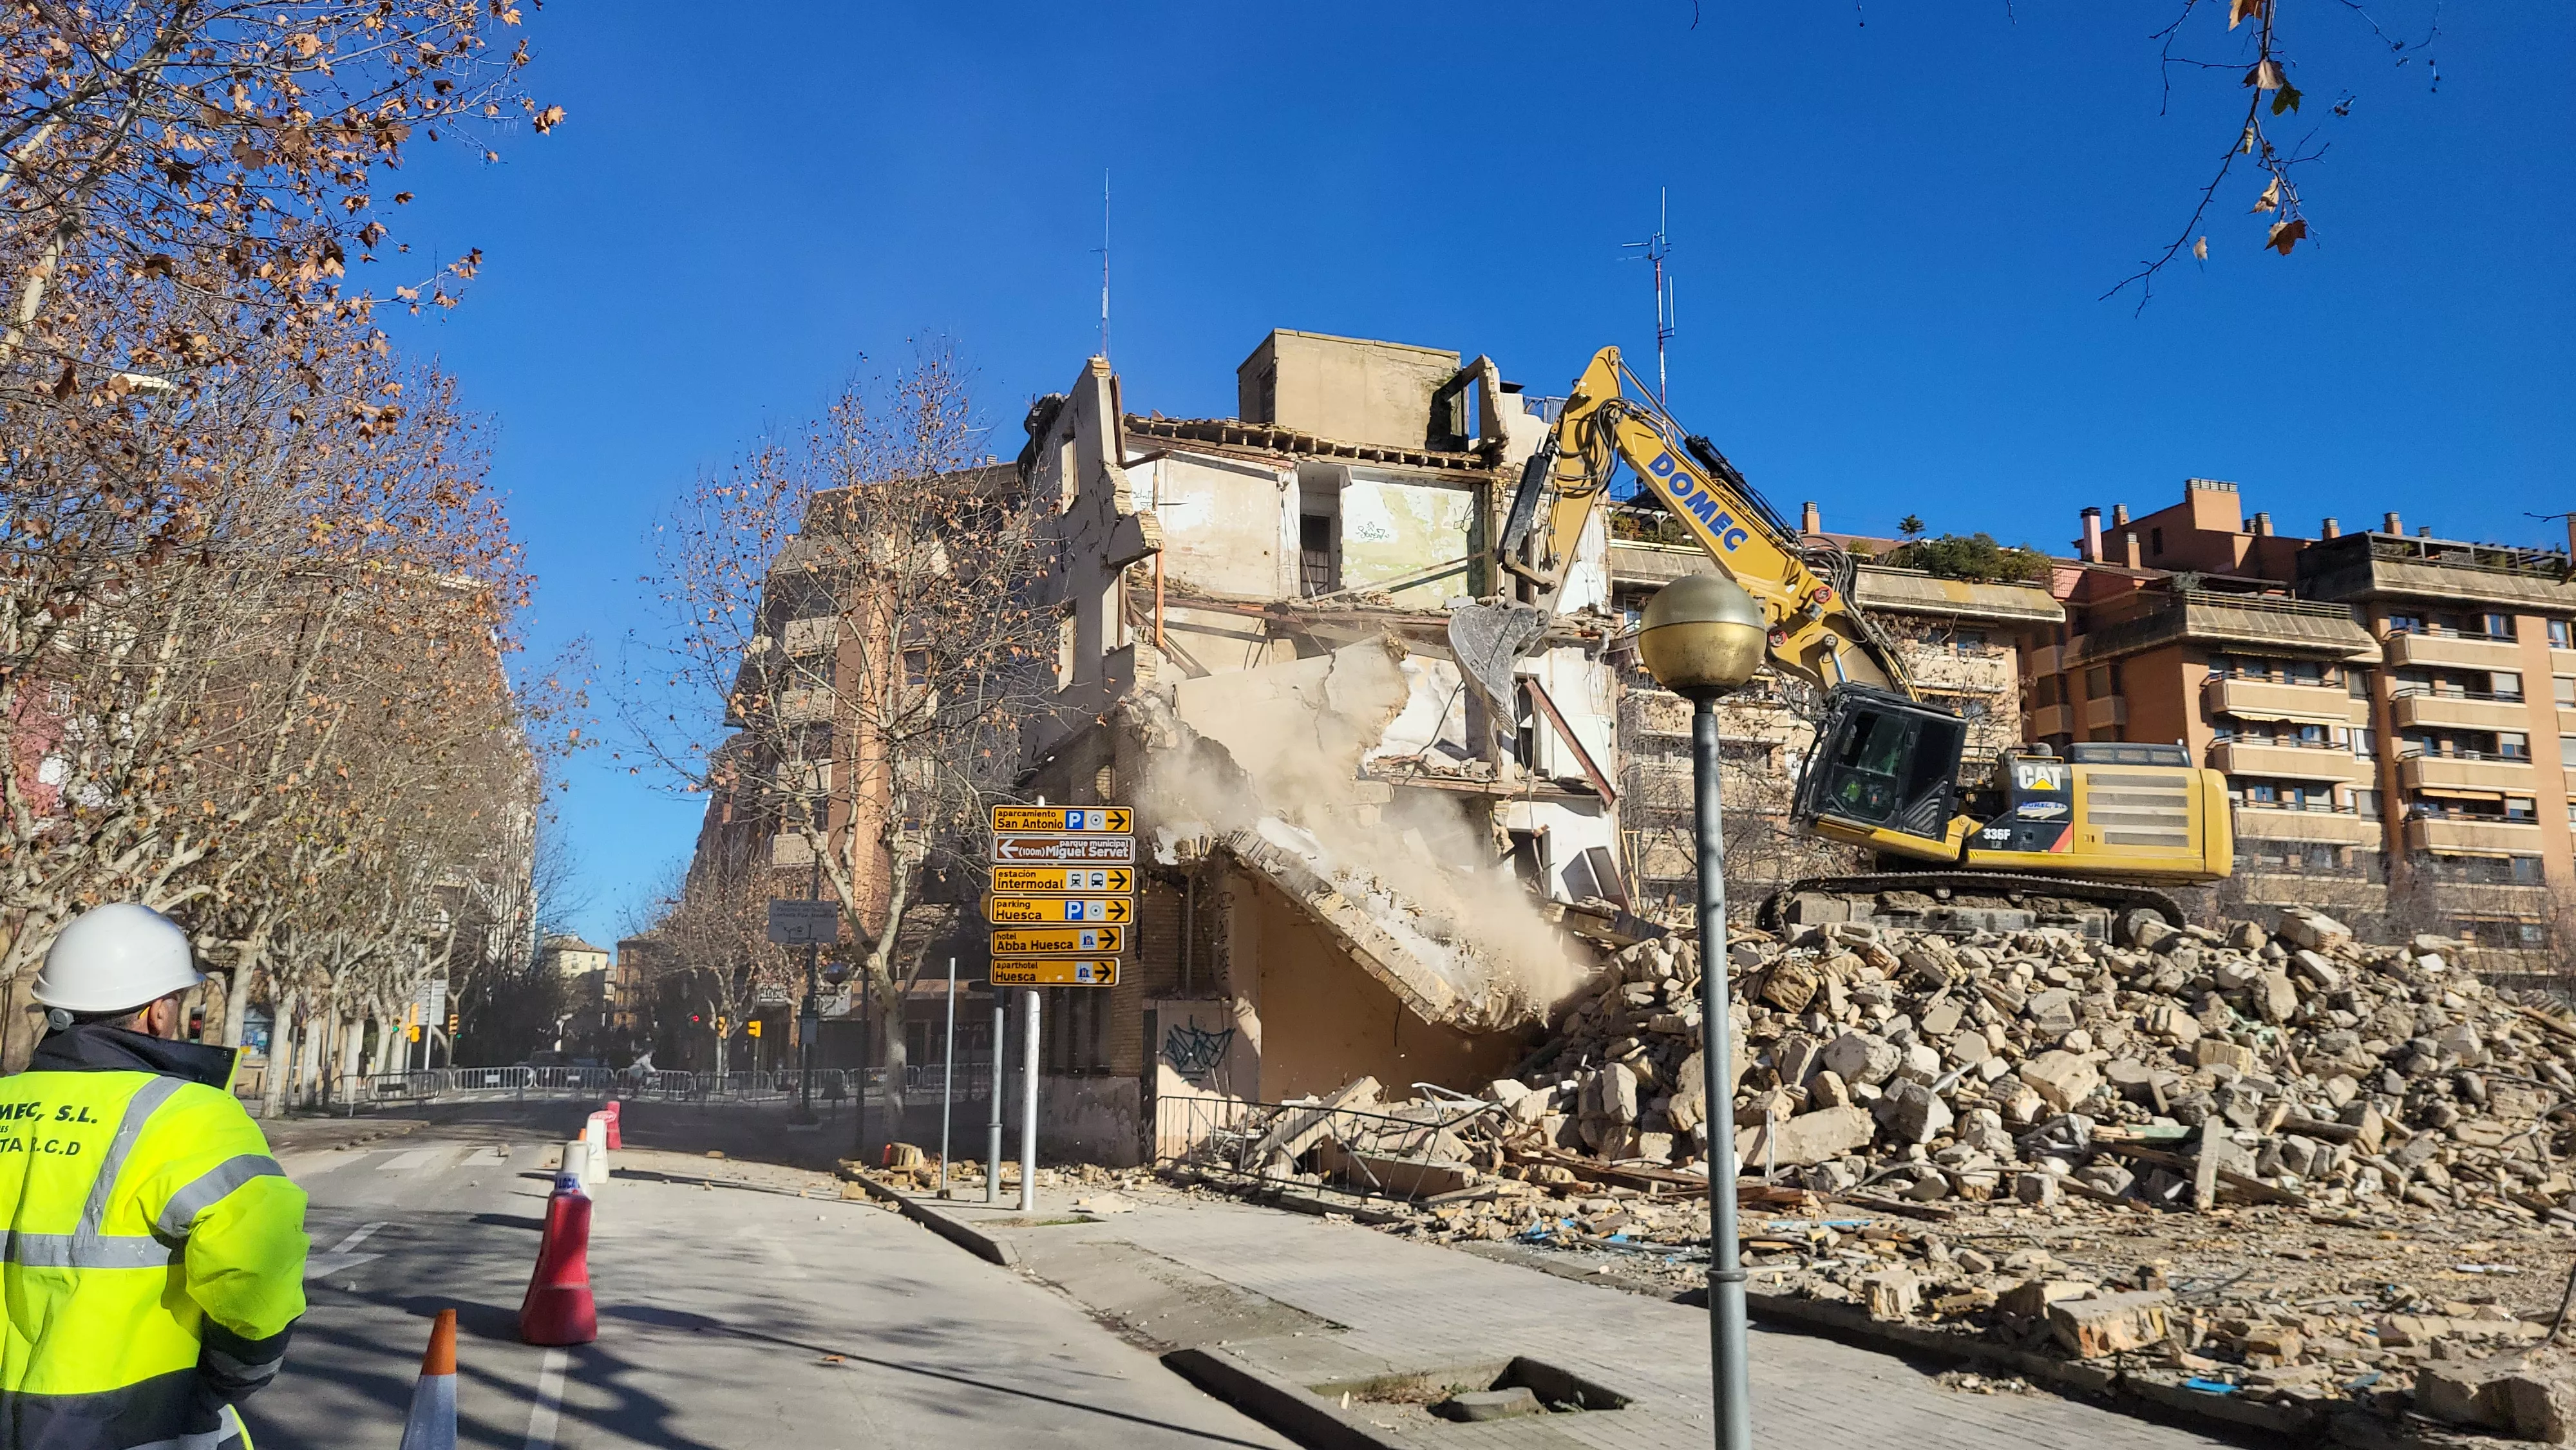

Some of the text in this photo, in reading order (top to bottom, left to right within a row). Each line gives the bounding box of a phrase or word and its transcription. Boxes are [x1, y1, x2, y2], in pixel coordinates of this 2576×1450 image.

[1648, 451, 1748, 552] DOMEC
[2018, 765, 2063, 791] CAT
[998, 809, 1056, 818] aparcamiento
[998, 818, 1063, 829] San Antonio
[1068, 812, 1081, 827] P
[1983, 828, 2011, 840] 336F
[1089, 839, 1128, 847] municipal
[1018, 845, 1129, 859] (100m) Miguel Servet
[998, 869, 1036, 878] estación
[998, 878, 1064, 889] intermodal
[997, 900, 1030, 909] parking
[1068, 901, 1081, 919] P
[996, 910, 1042, 920] Huesca
[997, 940, 1074, 951] Abba Huesca
[996, 972, 1036, 982] Huesca
[55, 1105, 98, 1124] S.L.
